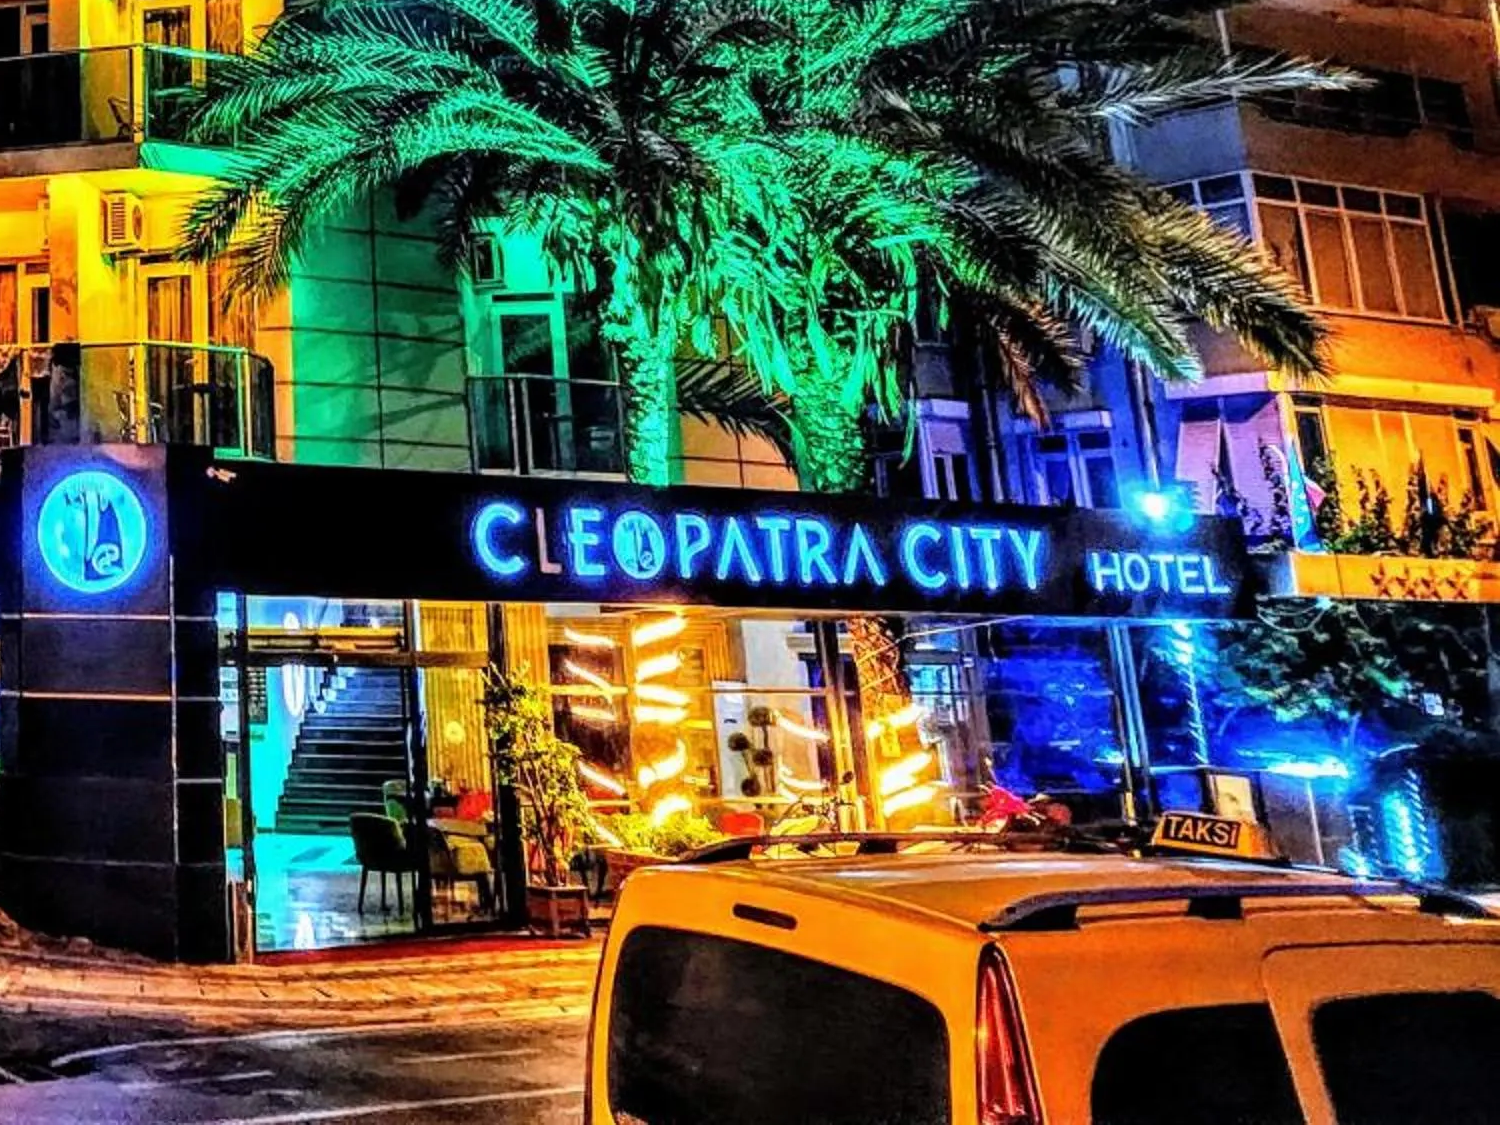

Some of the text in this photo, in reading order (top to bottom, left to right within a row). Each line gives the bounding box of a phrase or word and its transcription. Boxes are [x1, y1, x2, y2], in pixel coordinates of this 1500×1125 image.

[473, 503, 1232, 594] CLEOPATRA CITY HOTEL
